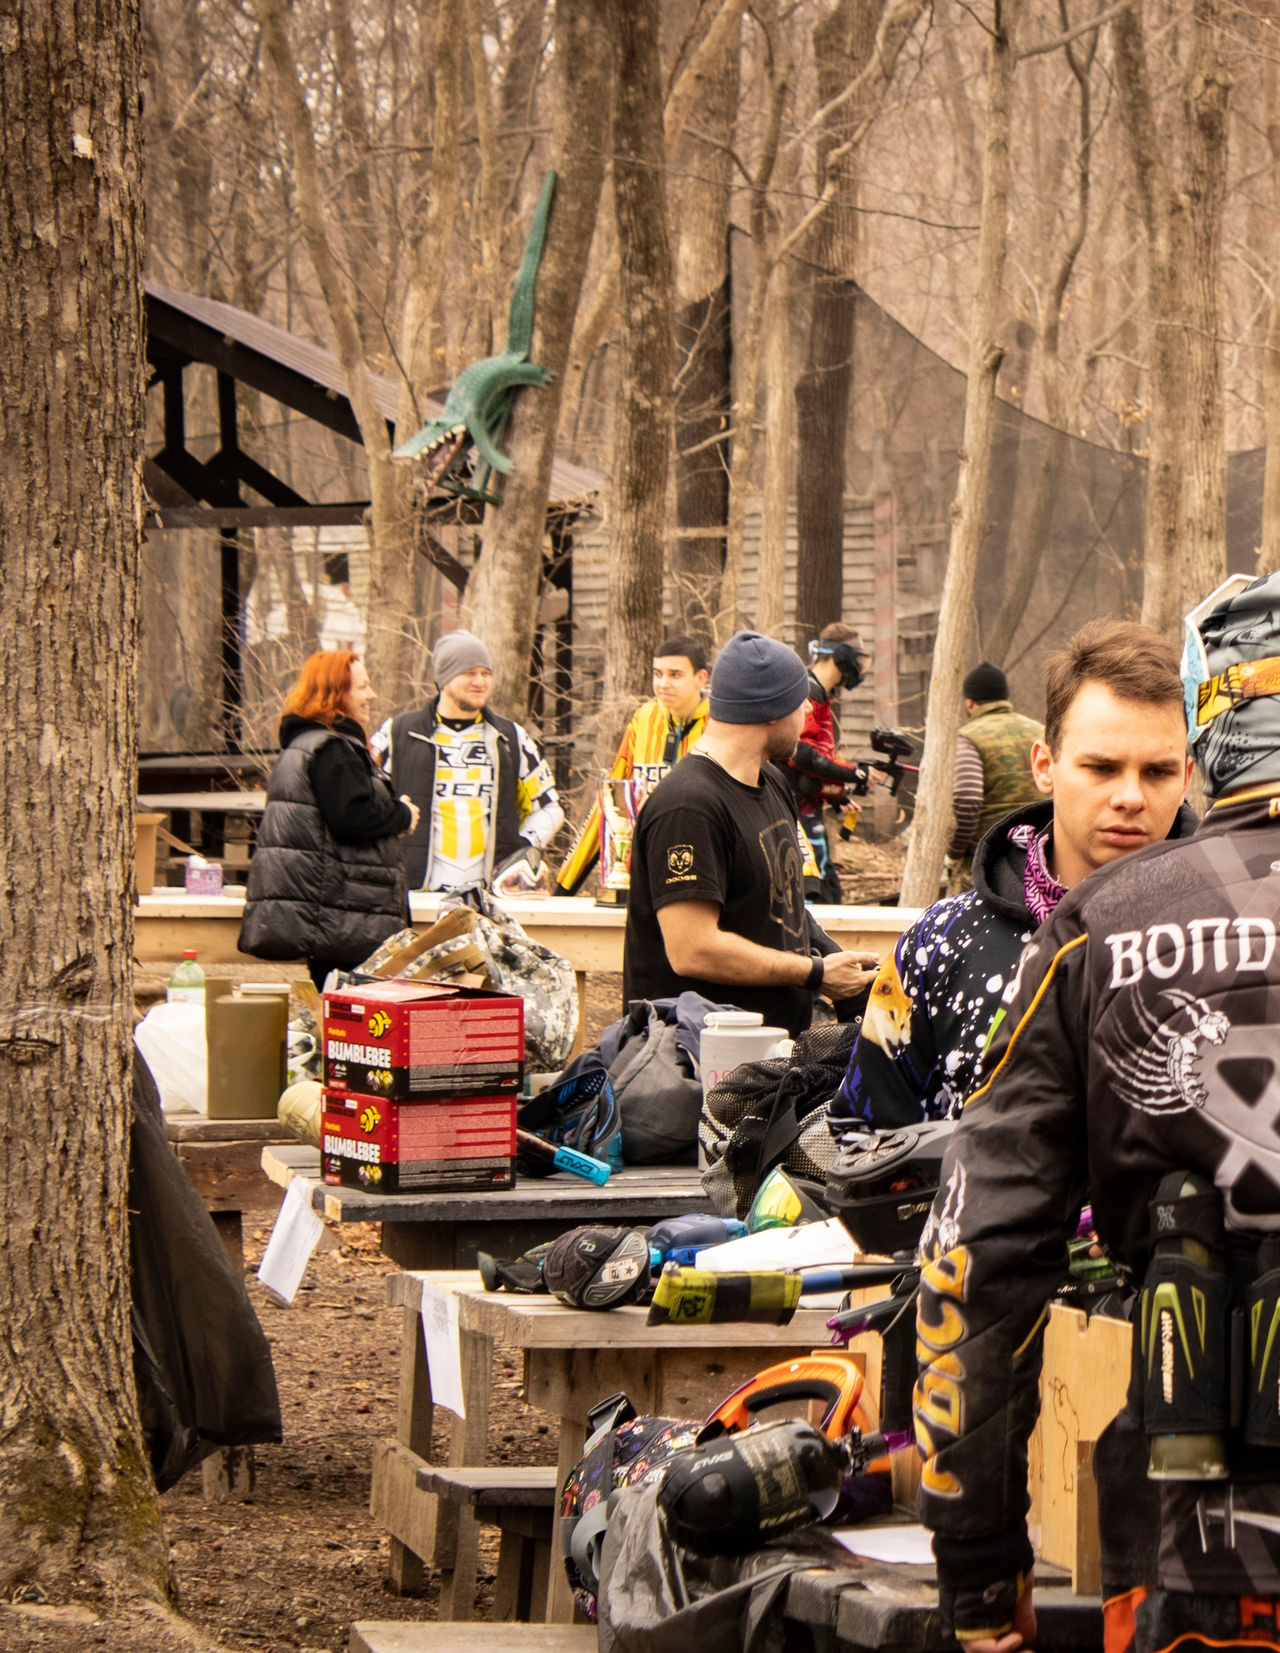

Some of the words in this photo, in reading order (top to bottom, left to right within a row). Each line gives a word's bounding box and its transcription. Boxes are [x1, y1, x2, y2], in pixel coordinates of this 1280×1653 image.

[666, 875, 698, 885] DODGE
[328, 1040, 391, 1069] BUMBLEBEE
[324, 1134, 381, 1164] BUMBLEBEE
[556, 1153, 595, 1175] EXALT
[690, 1450, 734, 1474] EXALT
